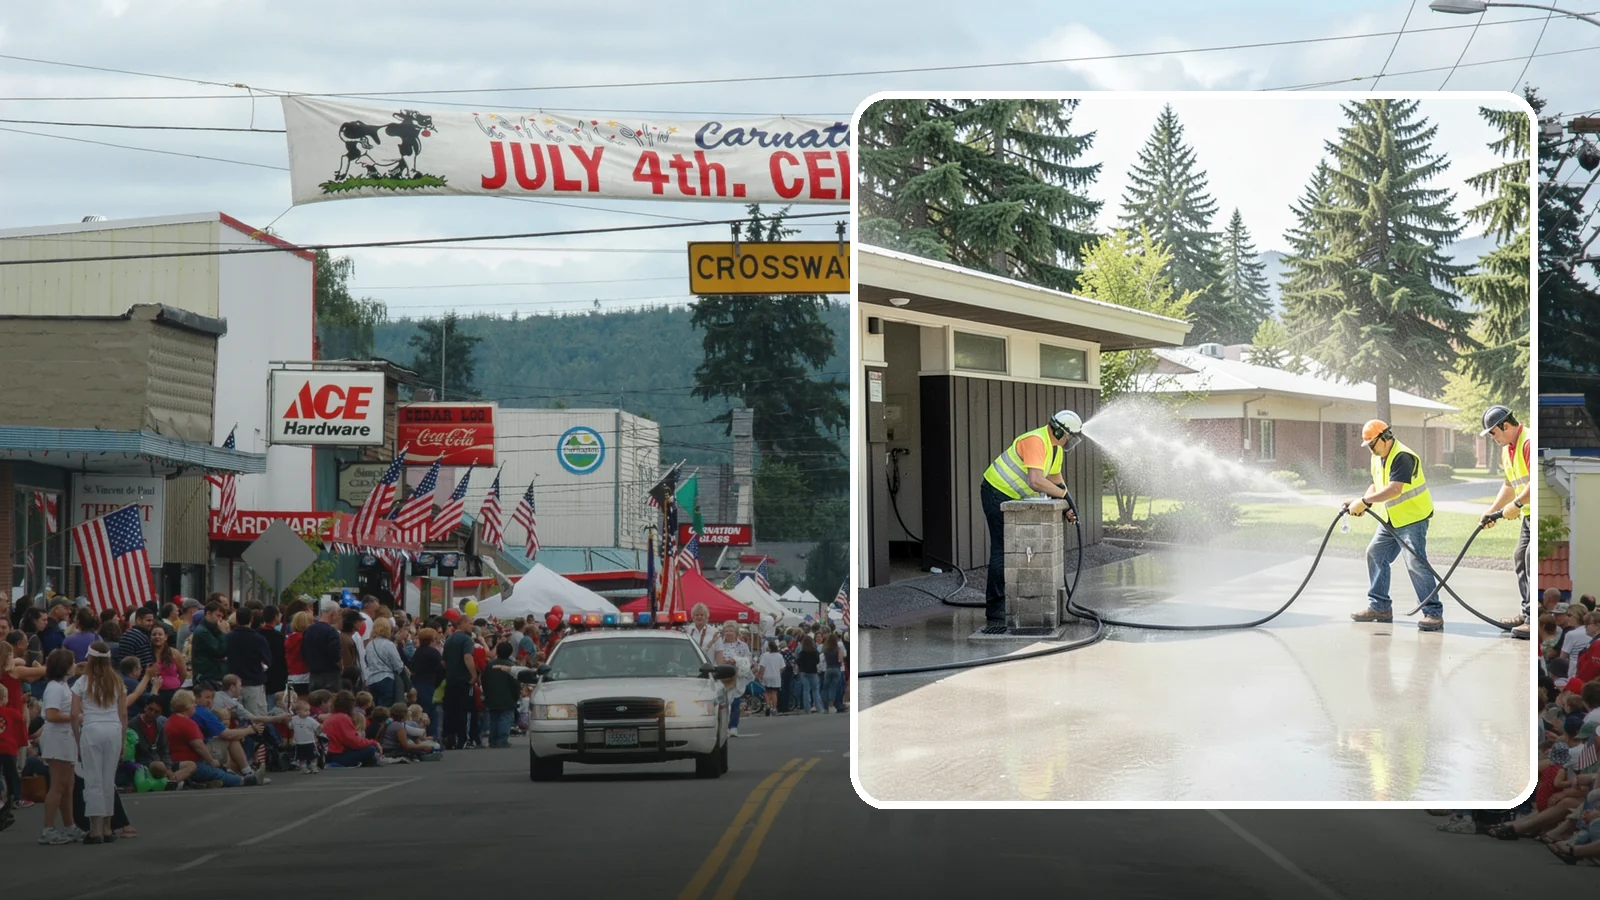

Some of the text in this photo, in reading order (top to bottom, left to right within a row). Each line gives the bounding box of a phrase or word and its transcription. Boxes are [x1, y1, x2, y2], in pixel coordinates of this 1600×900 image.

[481, 141, 605, 191] JULY
[632, 150, 746, 197] 4th.
[697, 254, 850, 280] CROSSWA
[283, 380, 373, 420] ACE
[406, 409, 453, 421] CEDAR
[283, 421, 370, 436] Hardware
[416, 428, 476, 447] Coca-Cola
[353, 467, 386, 483] Simpl
[96, 485, 124, 495] Vincent
[126, 486, 136, 495] de
[137, 486, 155, 495] Paul
[81, 503, 154, 522] THRT
[213, 516, 330, 536] HARDARE
[688, 526, 741, 535] CRNATION
[699, 535, 730, 544] GLASS
